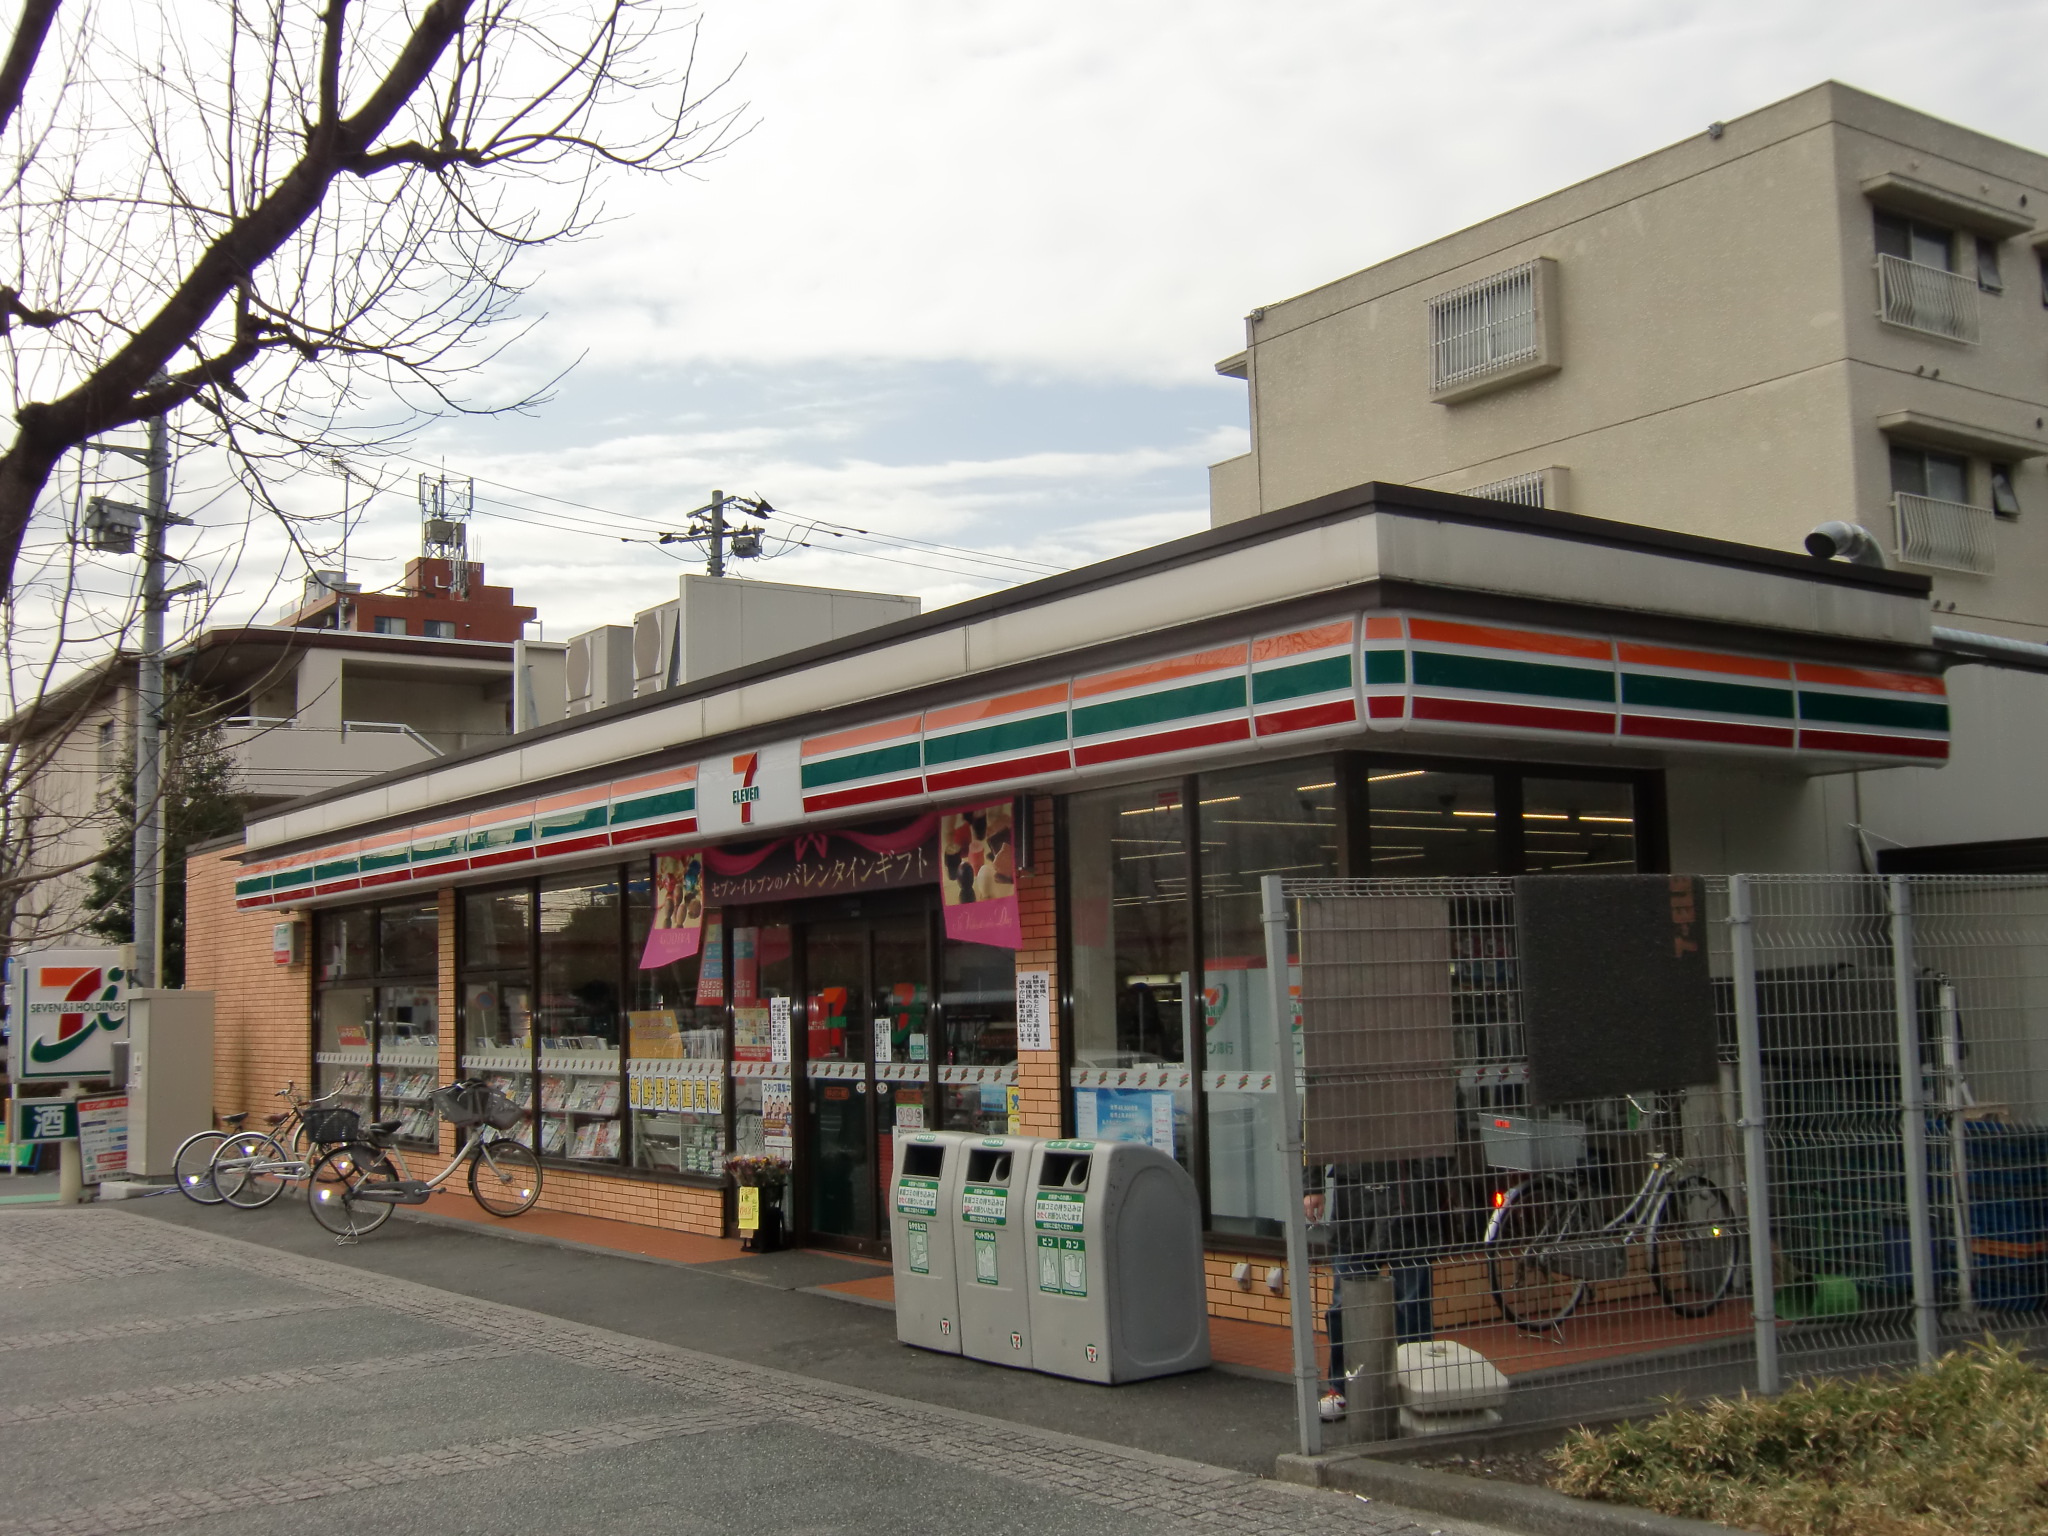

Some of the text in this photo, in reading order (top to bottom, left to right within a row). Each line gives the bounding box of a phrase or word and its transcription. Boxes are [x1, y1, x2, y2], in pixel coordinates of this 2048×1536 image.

[75, 1001, 127, 1012] HOLDINGS
[630, 1075, 721, 1110] 新鮮野菜直売所
[33, 1104, 67, 1138] 酒
[1065, 1239, 1079, 1250] カン
